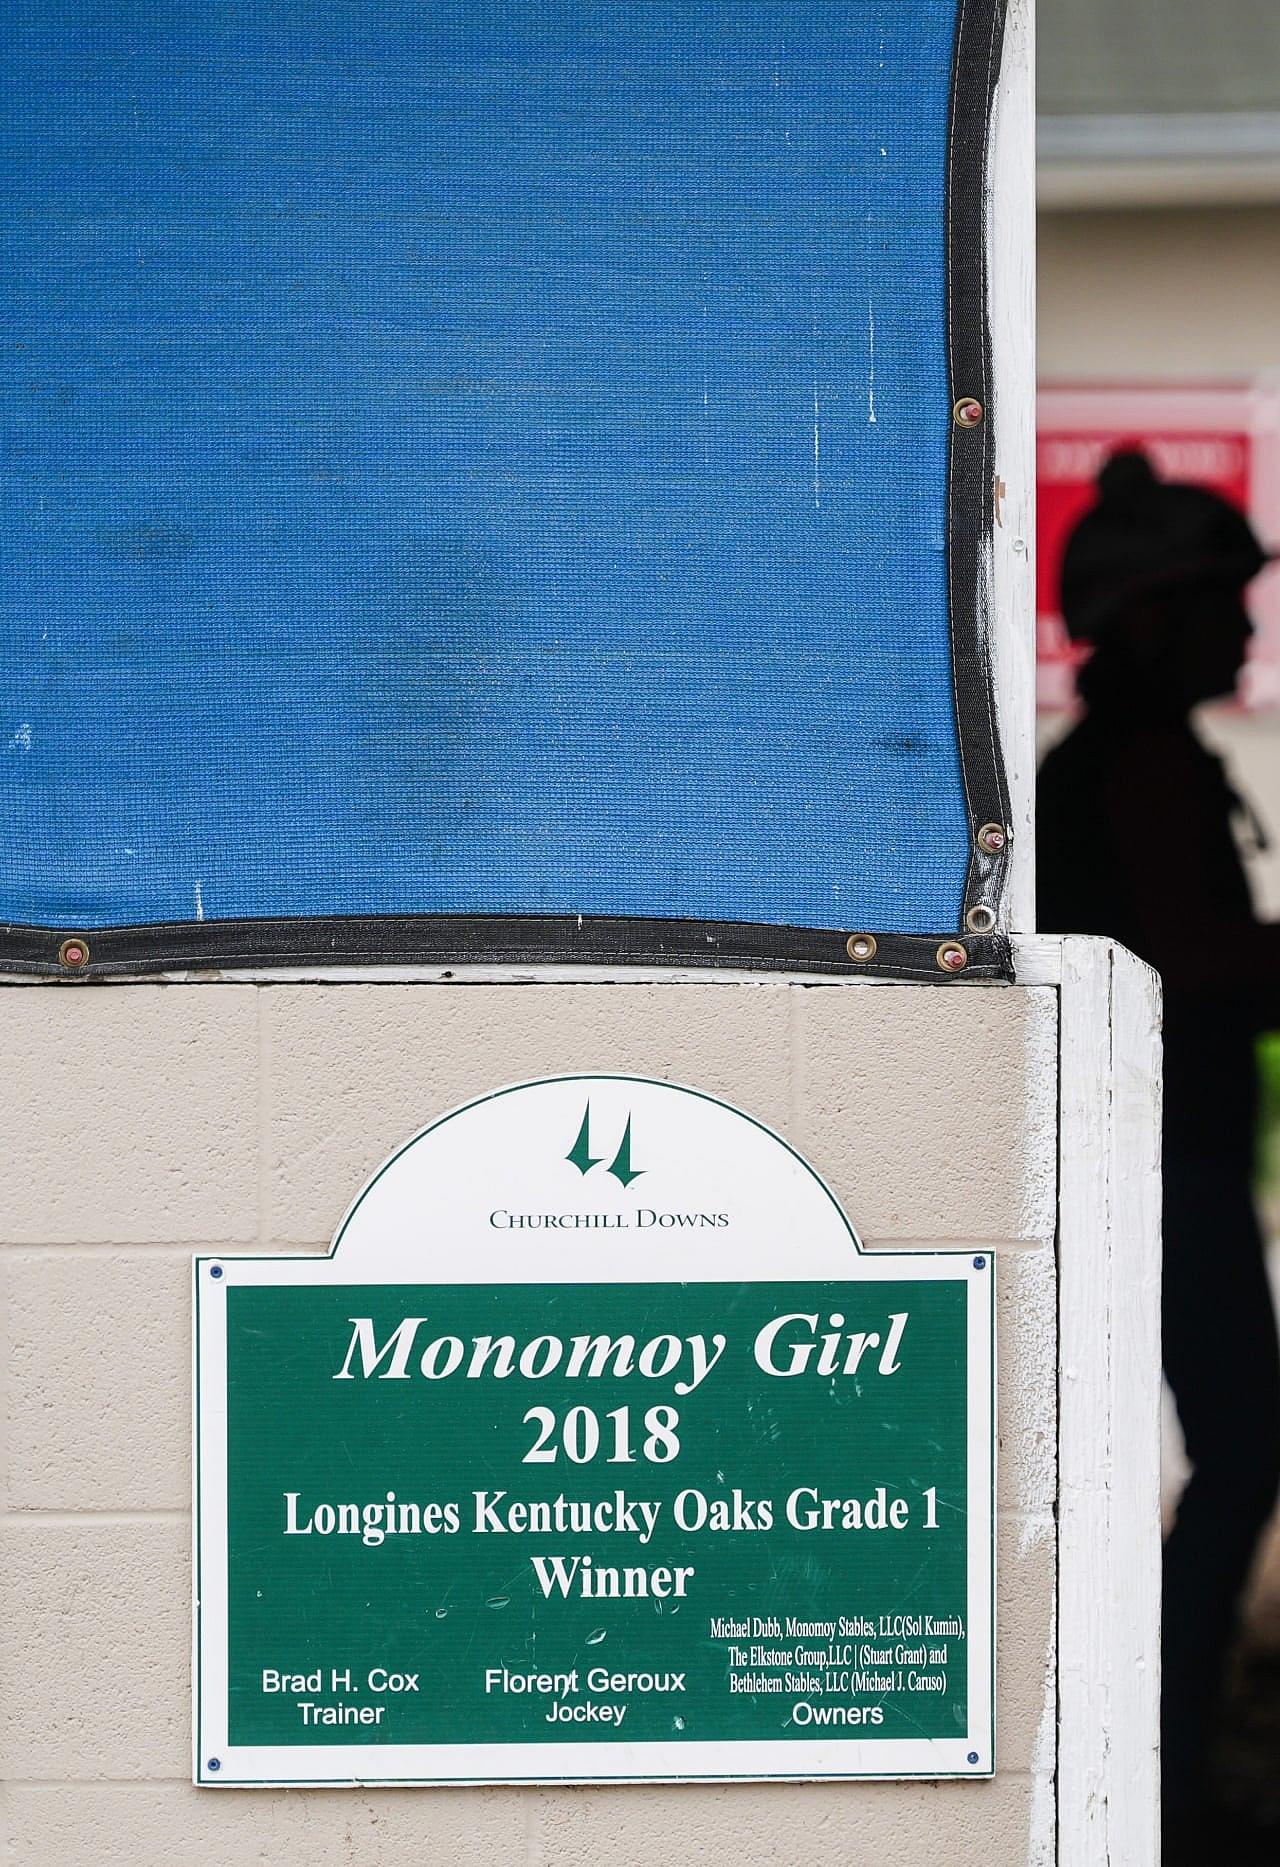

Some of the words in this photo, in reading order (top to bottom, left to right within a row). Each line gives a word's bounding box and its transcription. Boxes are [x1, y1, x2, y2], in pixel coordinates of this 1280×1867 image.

[332, 1317, 727, 1396] Monomoy
[754, 1312, 910, 1378] Girl
[521, 1405, 681, 1464] 2018
[283, 1491, 461, 1546] Longines
[471, 1490, 662, 1544] Kentucky
[673, 1488, 774, 1533] Oaks
[786, 1487, 910, 1532] Grade
[922, 1486, 940, 1530] 1
[530, 1555, 695, 1599] Winner
[710, 1617, 750, 1639] Michael
[752, 1617, 783, 1641] Dubb,
[786, 1617, 836, 1642] Monomoy
[838, 1616, 877, 1640] Stables,
[925, 1615, 965, 1639] Kumin),
[728, 1646, 748, 1667] The
[750, 1645, 793, 1667] Elkstone
[859, 1645, 893, 1669] (Stuart
[895, 1644, 927, 1669] Grant)
[929, 1644, 947, 1664] and
[262, 1669, 322, 1693] Brad
[331, 1669, 359, 1692] H.
[367, 1668, 420, 1692] Cox
[485, 1669, 579, 1693] Florent
[587, 1667, 686, 1693] Geroux
[730, 1672, 783, 1693] Bethlehem
[784, 1671, 823, 1695] Stables,
[825, 1671, 849, 1692] LLC
[851, 1671, 895, 1696] (Michael
[896, 1671, 906, 1691] J.
[908, 1670, 947, 1695] Caruso)
[297, 1702, 386, 1725] Trainer
[545, 1701, 627, 1727] Jockey
[792, 1702, 885, 1726] Owners
